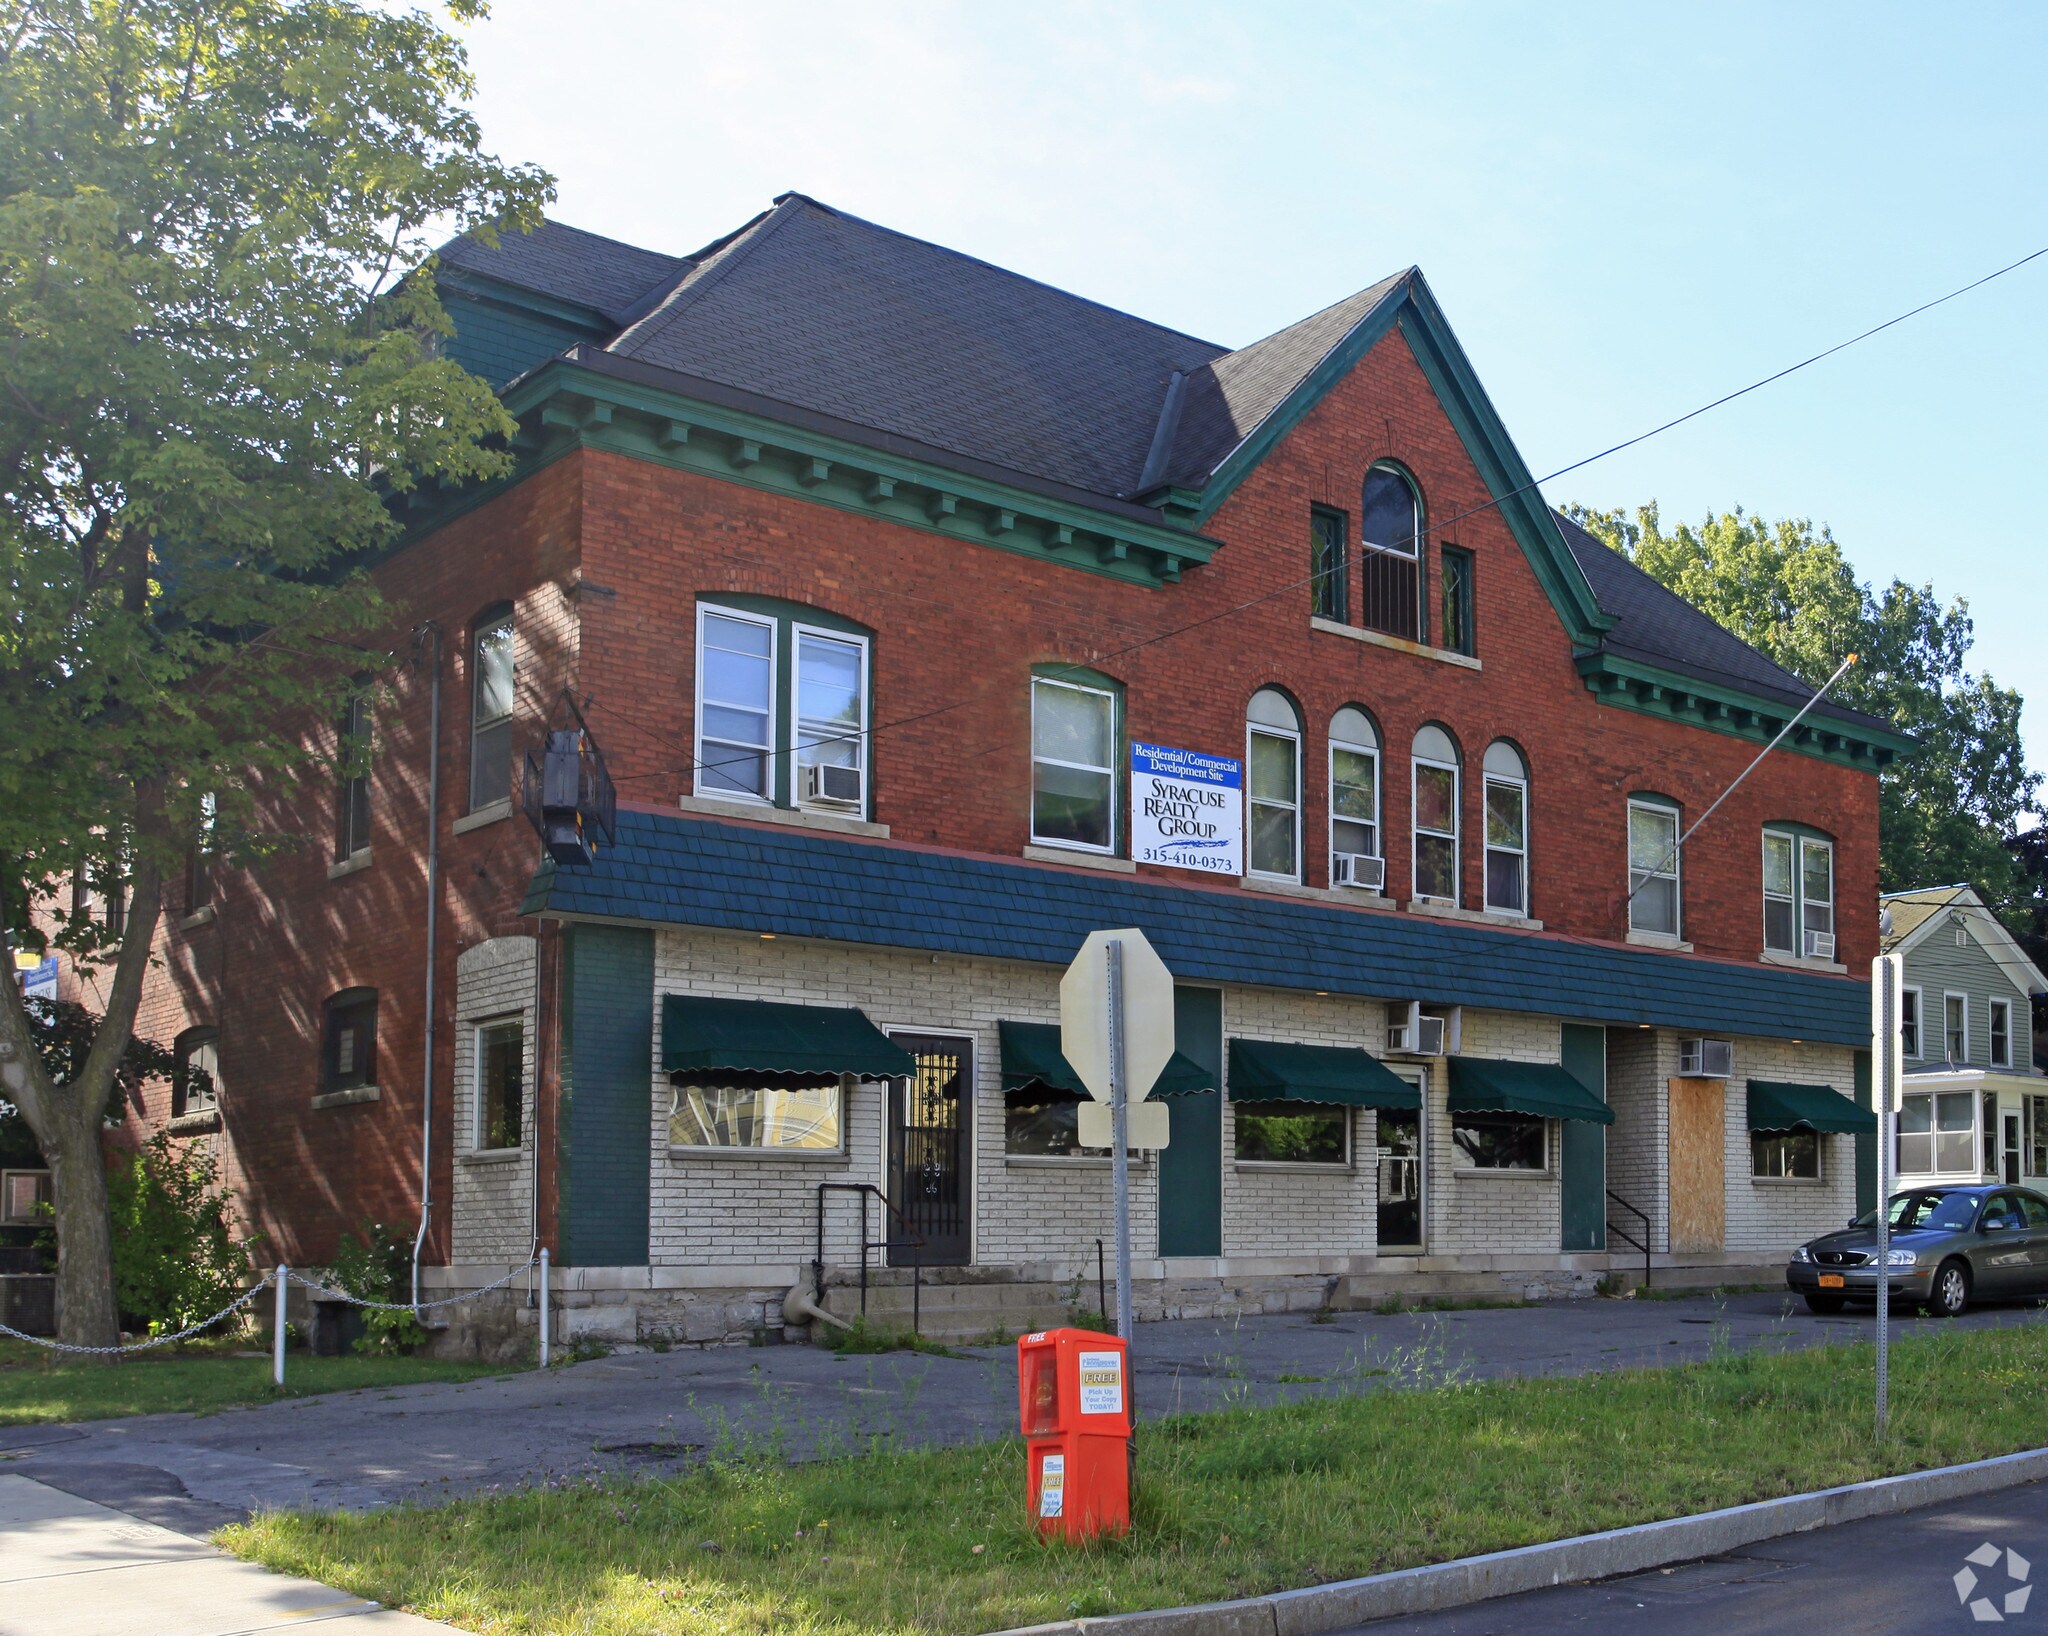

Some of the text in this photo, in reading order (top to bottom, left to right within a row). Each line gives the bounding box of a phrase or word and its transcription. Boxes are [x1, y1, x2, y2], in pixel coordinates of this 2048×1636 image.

[1135, 743, 1238, 773] Residential/Commercial
[1150, 758, 1224, 782] Development Site
[1151, 778, 1226, 808] SYRACUSE
[1143, 797, 1199, 819] REALTY
[1158, 816, 1217, 838] GROUP
[1143, 848, 1232, 871] 315-410-0373
[1027, 1332, 1046, 1343] FREE
[1085, 1373, 1117, 1383] FREE
